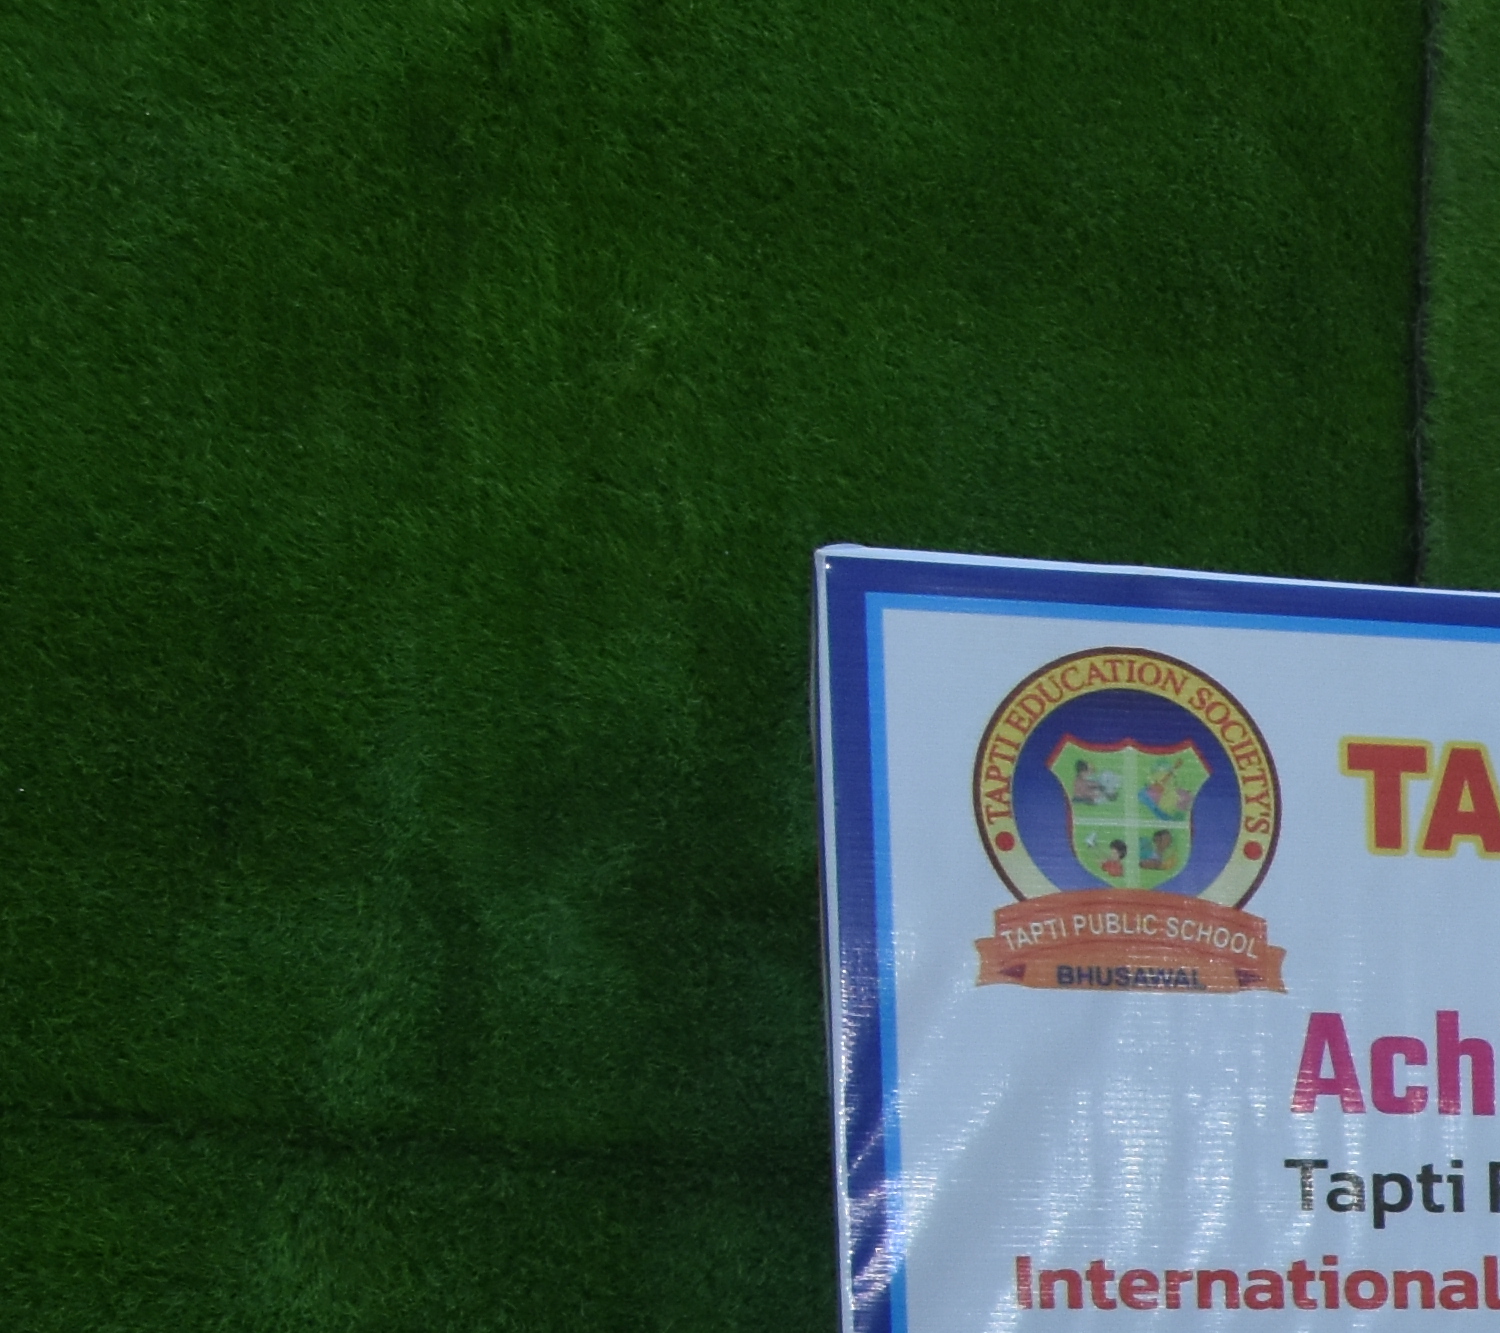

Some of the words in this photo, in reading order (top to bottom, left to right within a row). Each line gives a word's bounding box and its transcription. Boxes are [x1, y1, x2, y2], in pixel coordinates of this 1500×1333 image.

[984, 734, 1013, 825] TAPTI
[1004, 659, 1191, 730] EDUCATION
[1188, 686, 1271, 836] SOCIETY'S
[1001, 916, 1068, 951] TAPTI
[1073, 912, 1159, 938] PUBLIC
[1165, 916, 1259, 959] SCHOOL
[1055, 964, 1207, 990] BHUSAWAL
[1284, 1159, 1466, 1229] Tapti
